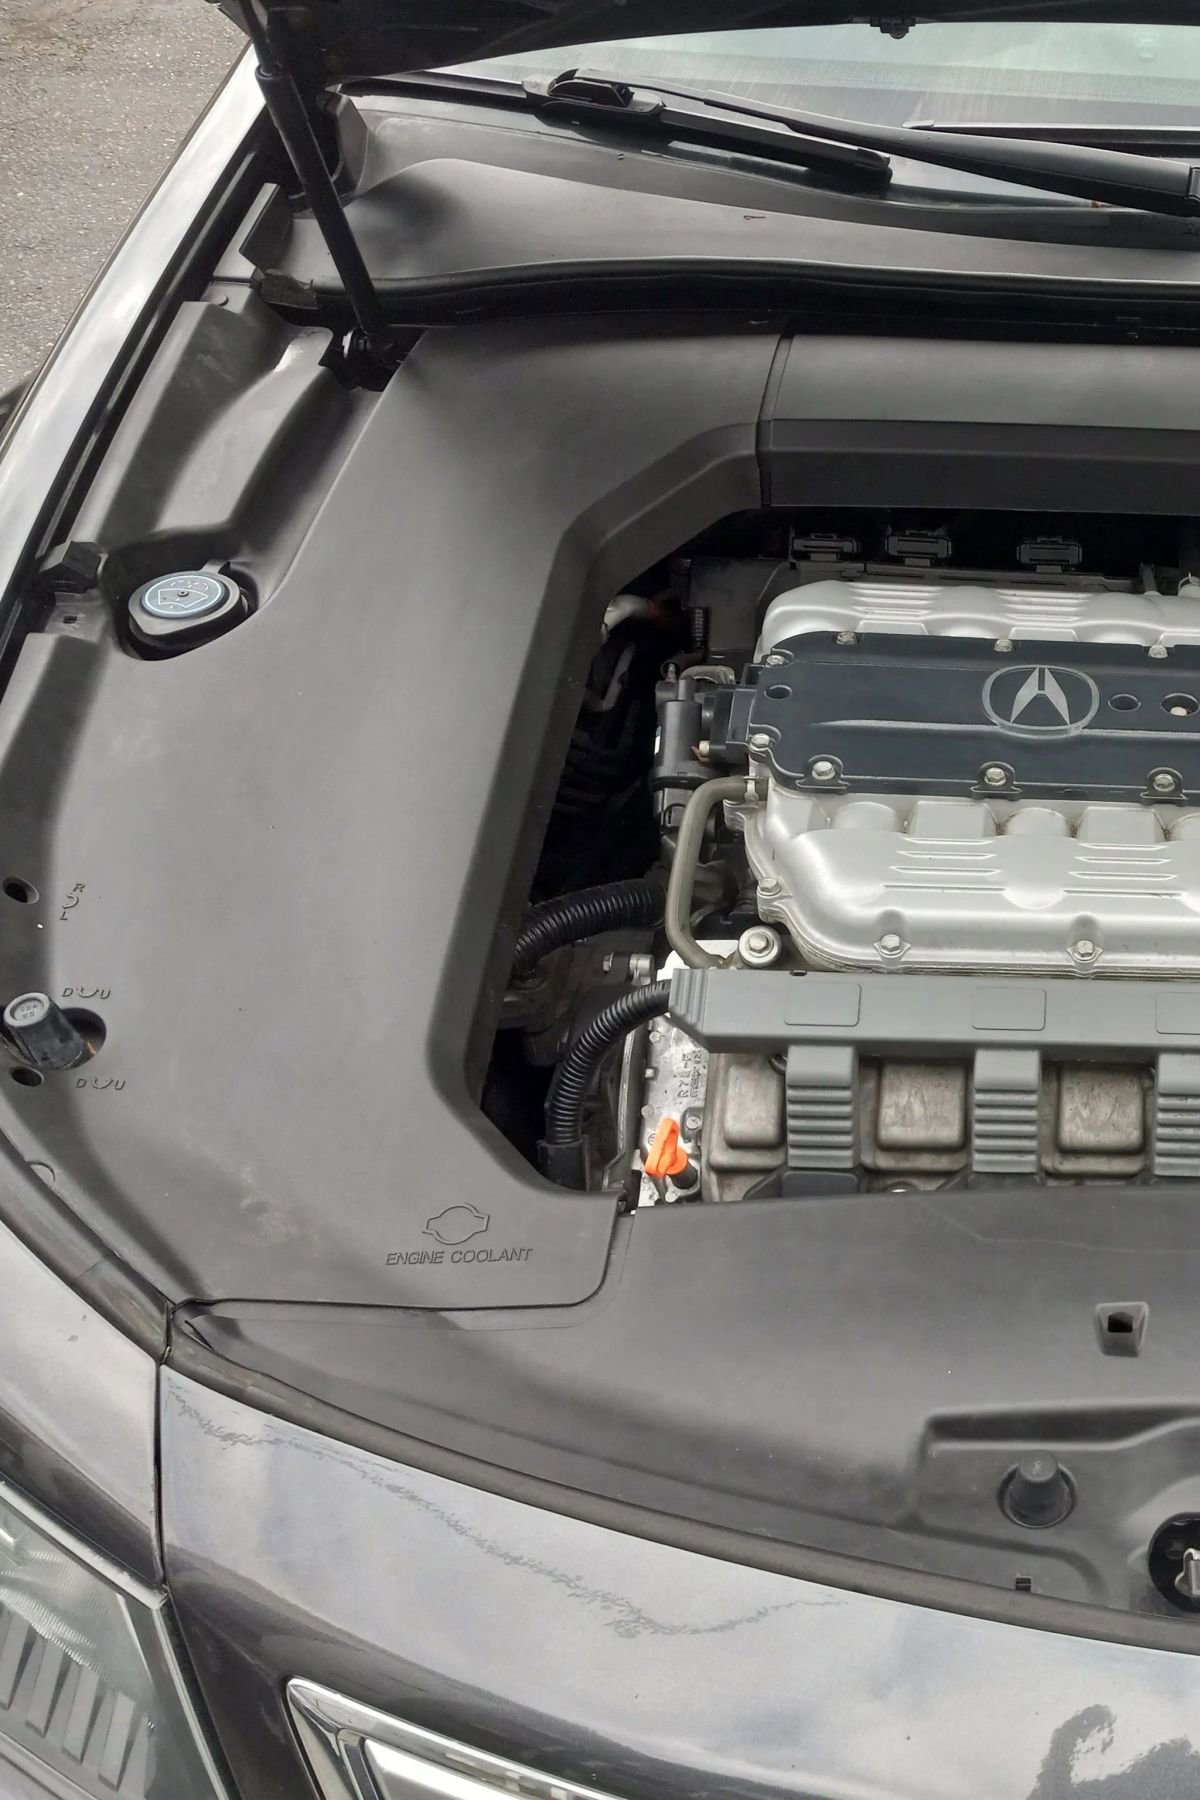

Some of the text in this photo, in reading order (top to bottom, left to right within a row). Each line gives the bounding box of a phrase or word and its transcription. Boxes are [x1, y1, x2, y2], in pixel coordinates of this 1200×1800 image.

[72, 883, 86, 893] R
[60, 911, 69, 921] L
[62, 988, 111, 999] D U
[75, 1078, 126, 1090] D U
[385, 1248, 534, 1266] ENGINE COOLANT
